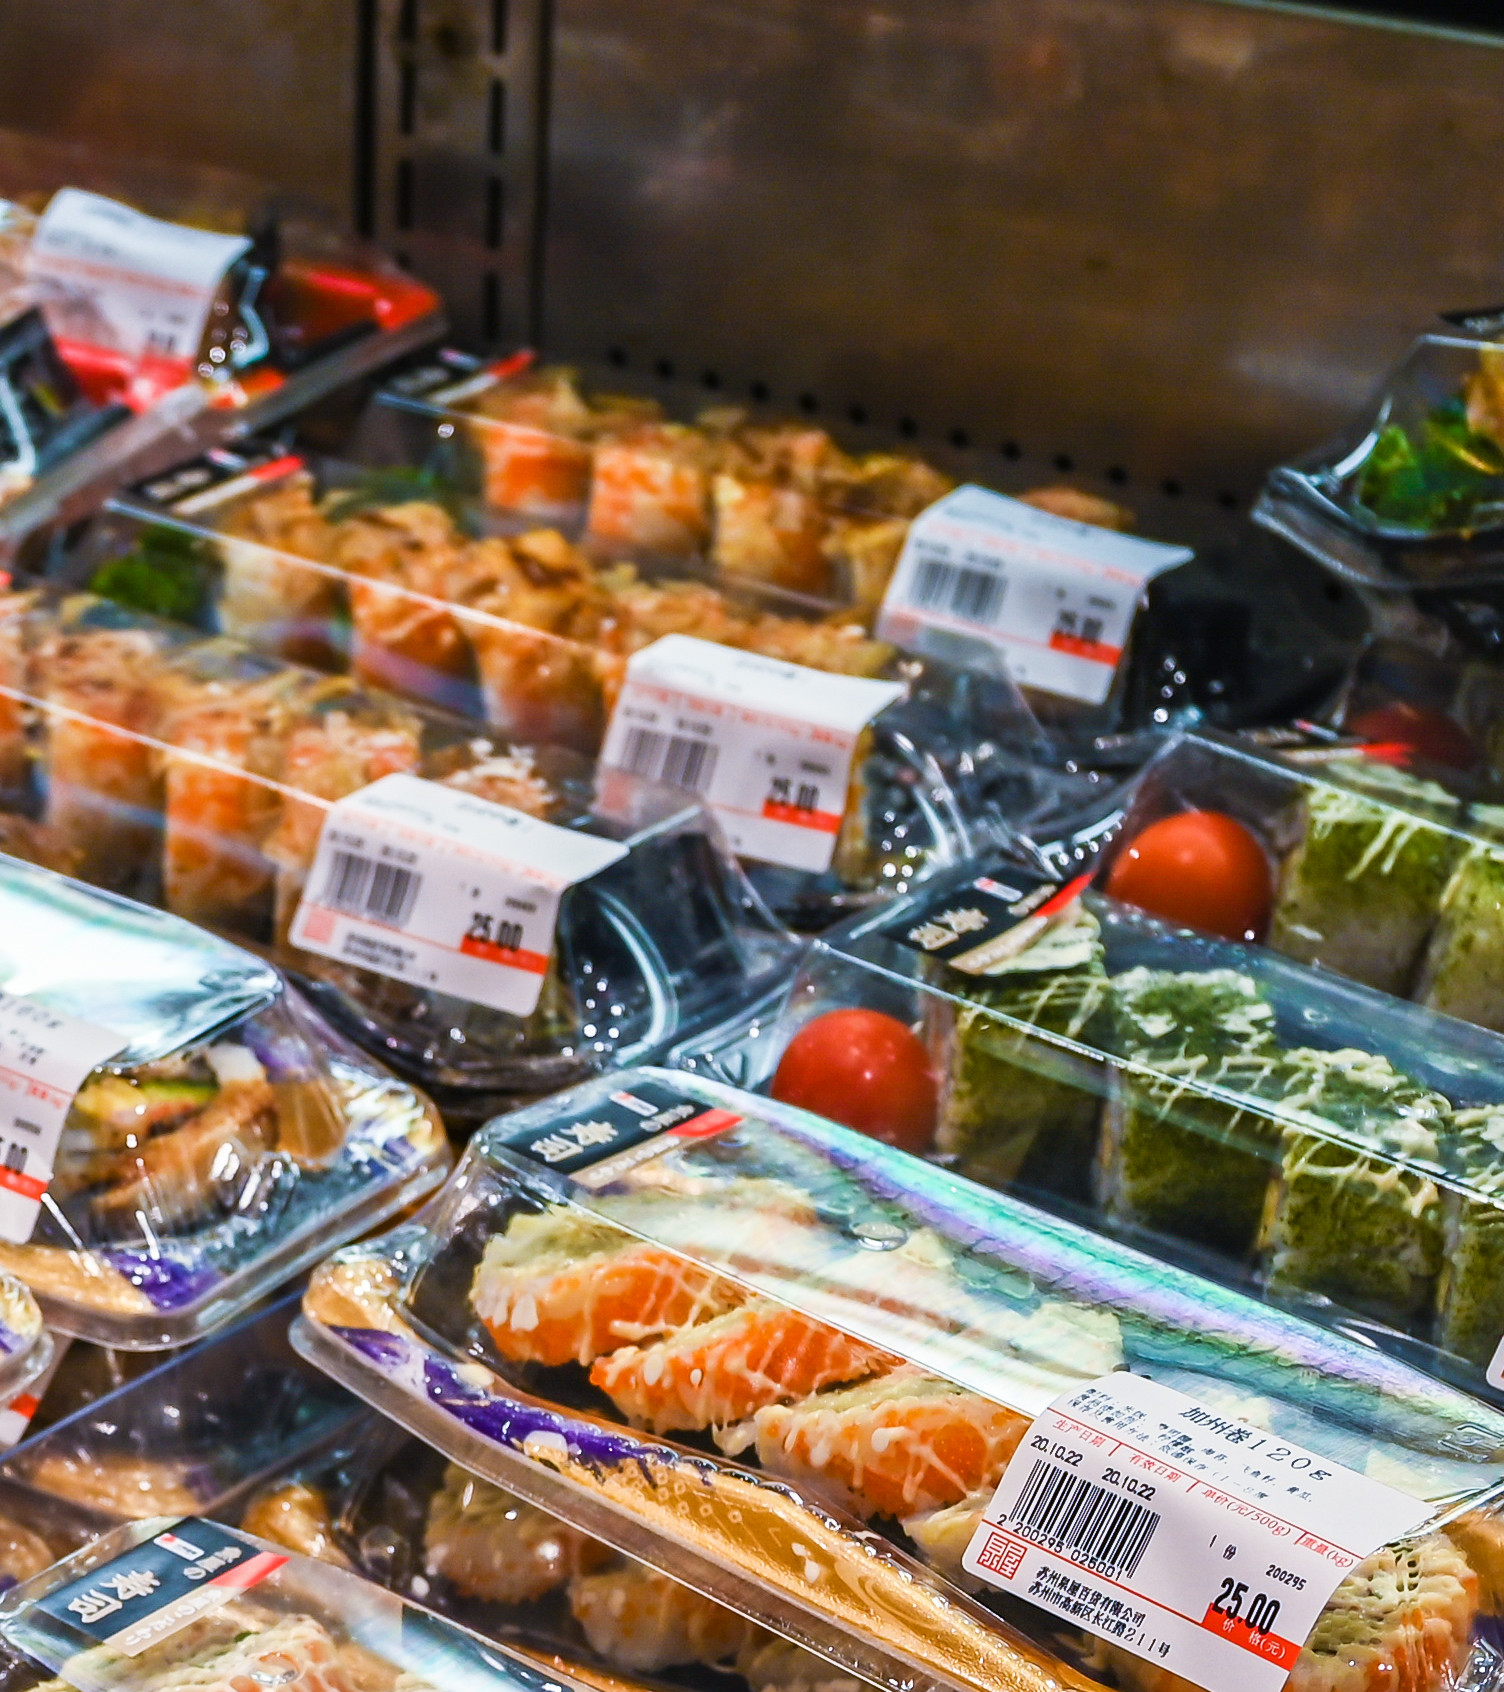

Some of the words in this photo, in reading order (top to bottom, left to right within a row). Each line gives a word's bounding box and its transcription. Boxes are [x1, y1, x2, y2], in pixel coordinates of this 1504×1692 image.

[470, 912, 523, 952] 25.00
[529, 1120, 619, 1161] 寿司
[1031, 1435, 1084, 1468] 20.10.22
[1101, 1468, 1156, 1500] 20.10.22
[1178, 1406, 1333, 1483] 加州卷120g
[1052, 1420, 1104, 1447] 生产日期
[1129, 1453, 1182, 1483] 有效日期
[1202, 1487, 1292, 1538] 单价(元/500g)
[1301, 1533, 1354, 1567] 重量(kg)
[997, 1514, 1007, 1526] 2
[1012, 1522, 1065, 1554] 200295
[1071, 1551, 1121, 1581] 025001
[1210, 1535, 1217, 1547] 1
[1222, 1545, 1236, 1560] 份
[1266, 1564, 1306, 1591] 200295
[68, 1569, 161, 1624] 寿司
[1027, 1580, 1171, 1658] 苏州市高新区长江路211号
[1211, 1577, 1281, 1636] 25.00
[1248, 1632, 1287, 1660] 格(元)
